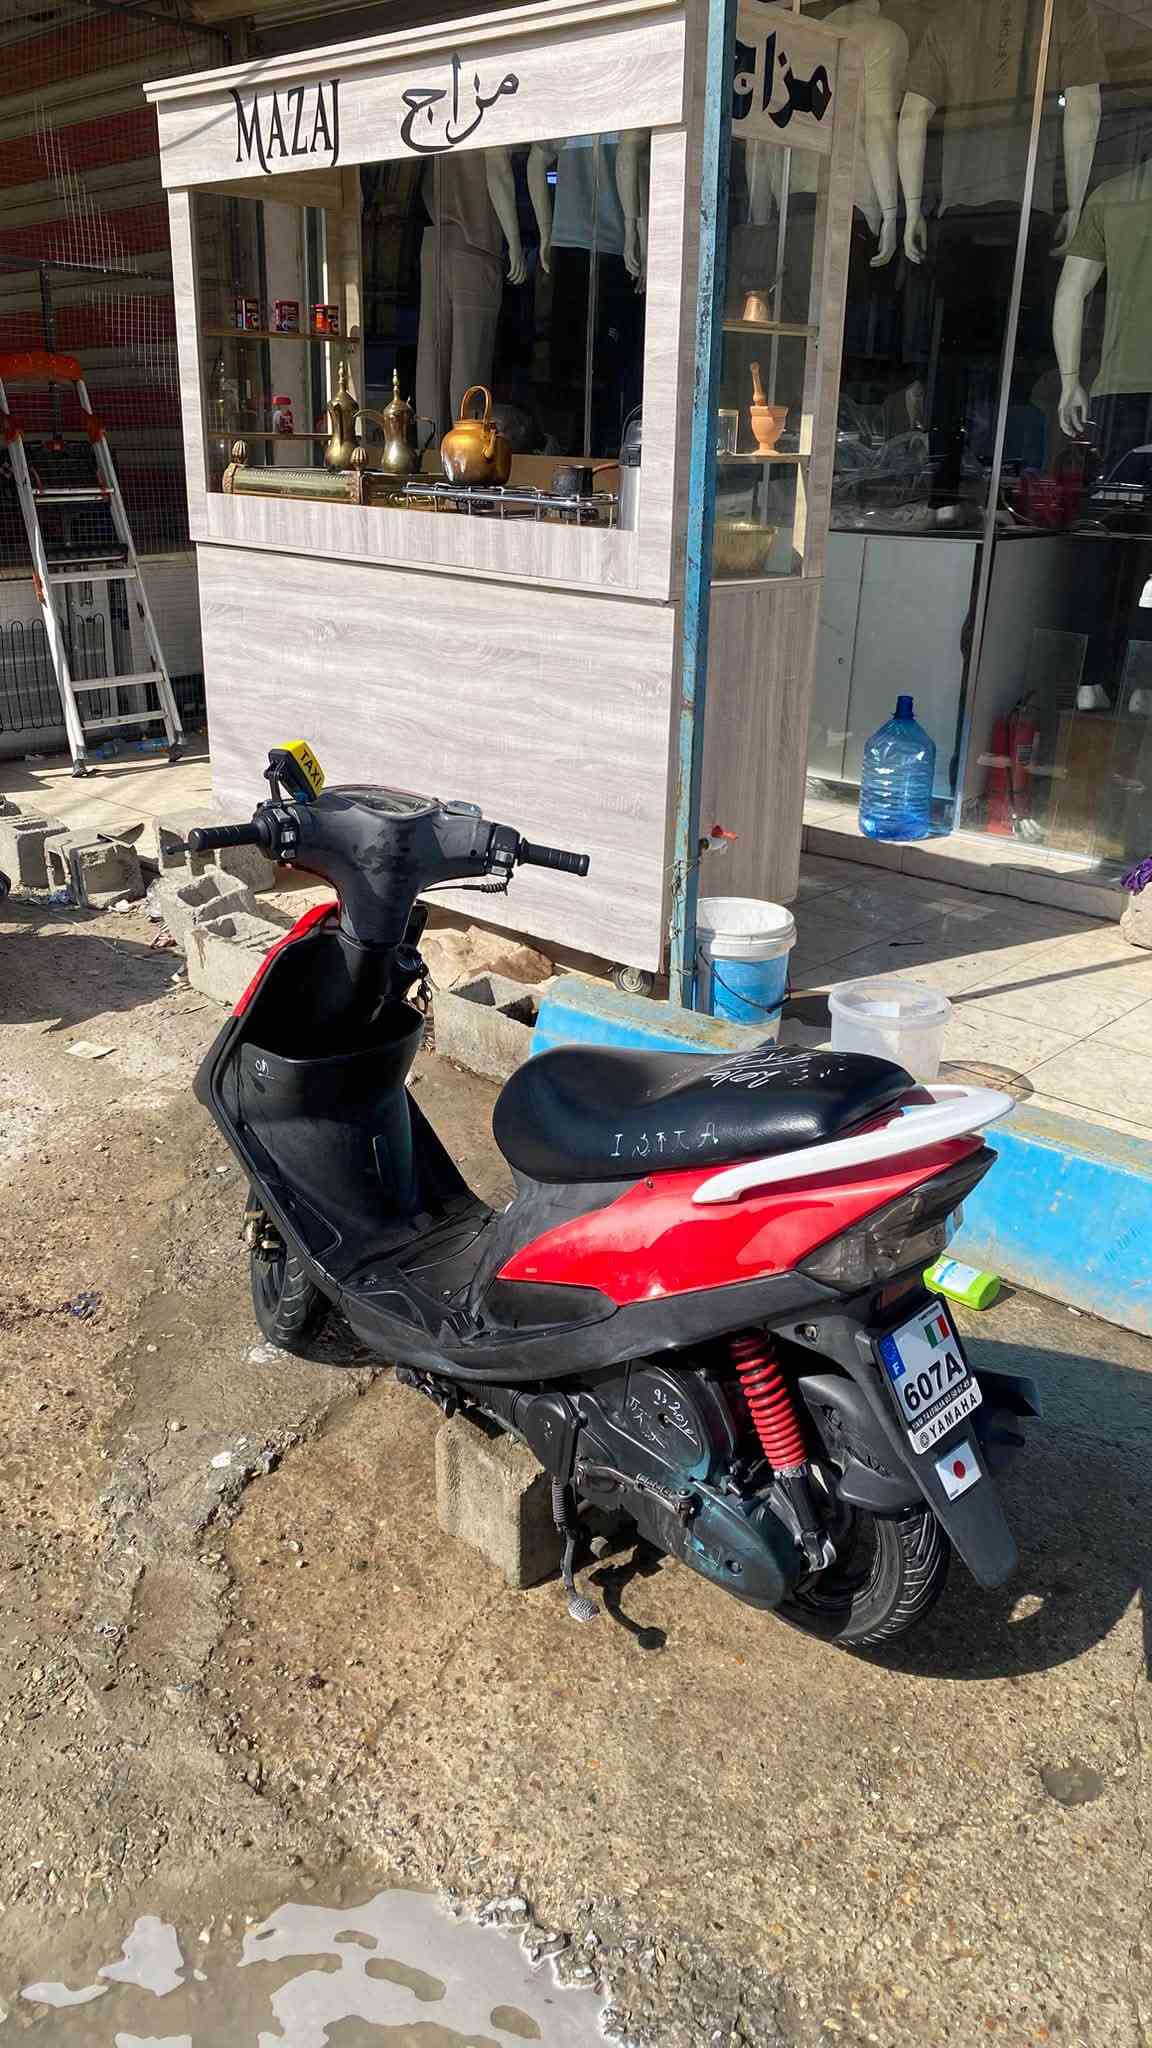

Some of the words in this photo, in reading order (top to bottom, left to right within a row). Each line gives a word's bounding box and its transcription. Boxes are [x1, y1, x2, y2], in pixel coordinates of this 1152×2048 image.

[229, 79, 341, 174] MAZAJ
[401, 53, 520, 153] مزاج
[300, 749, 322, 787] TAXI
[903, 1351, 963, 1412] 607A
[929, 1392, 978, 1439] YAMAHA
